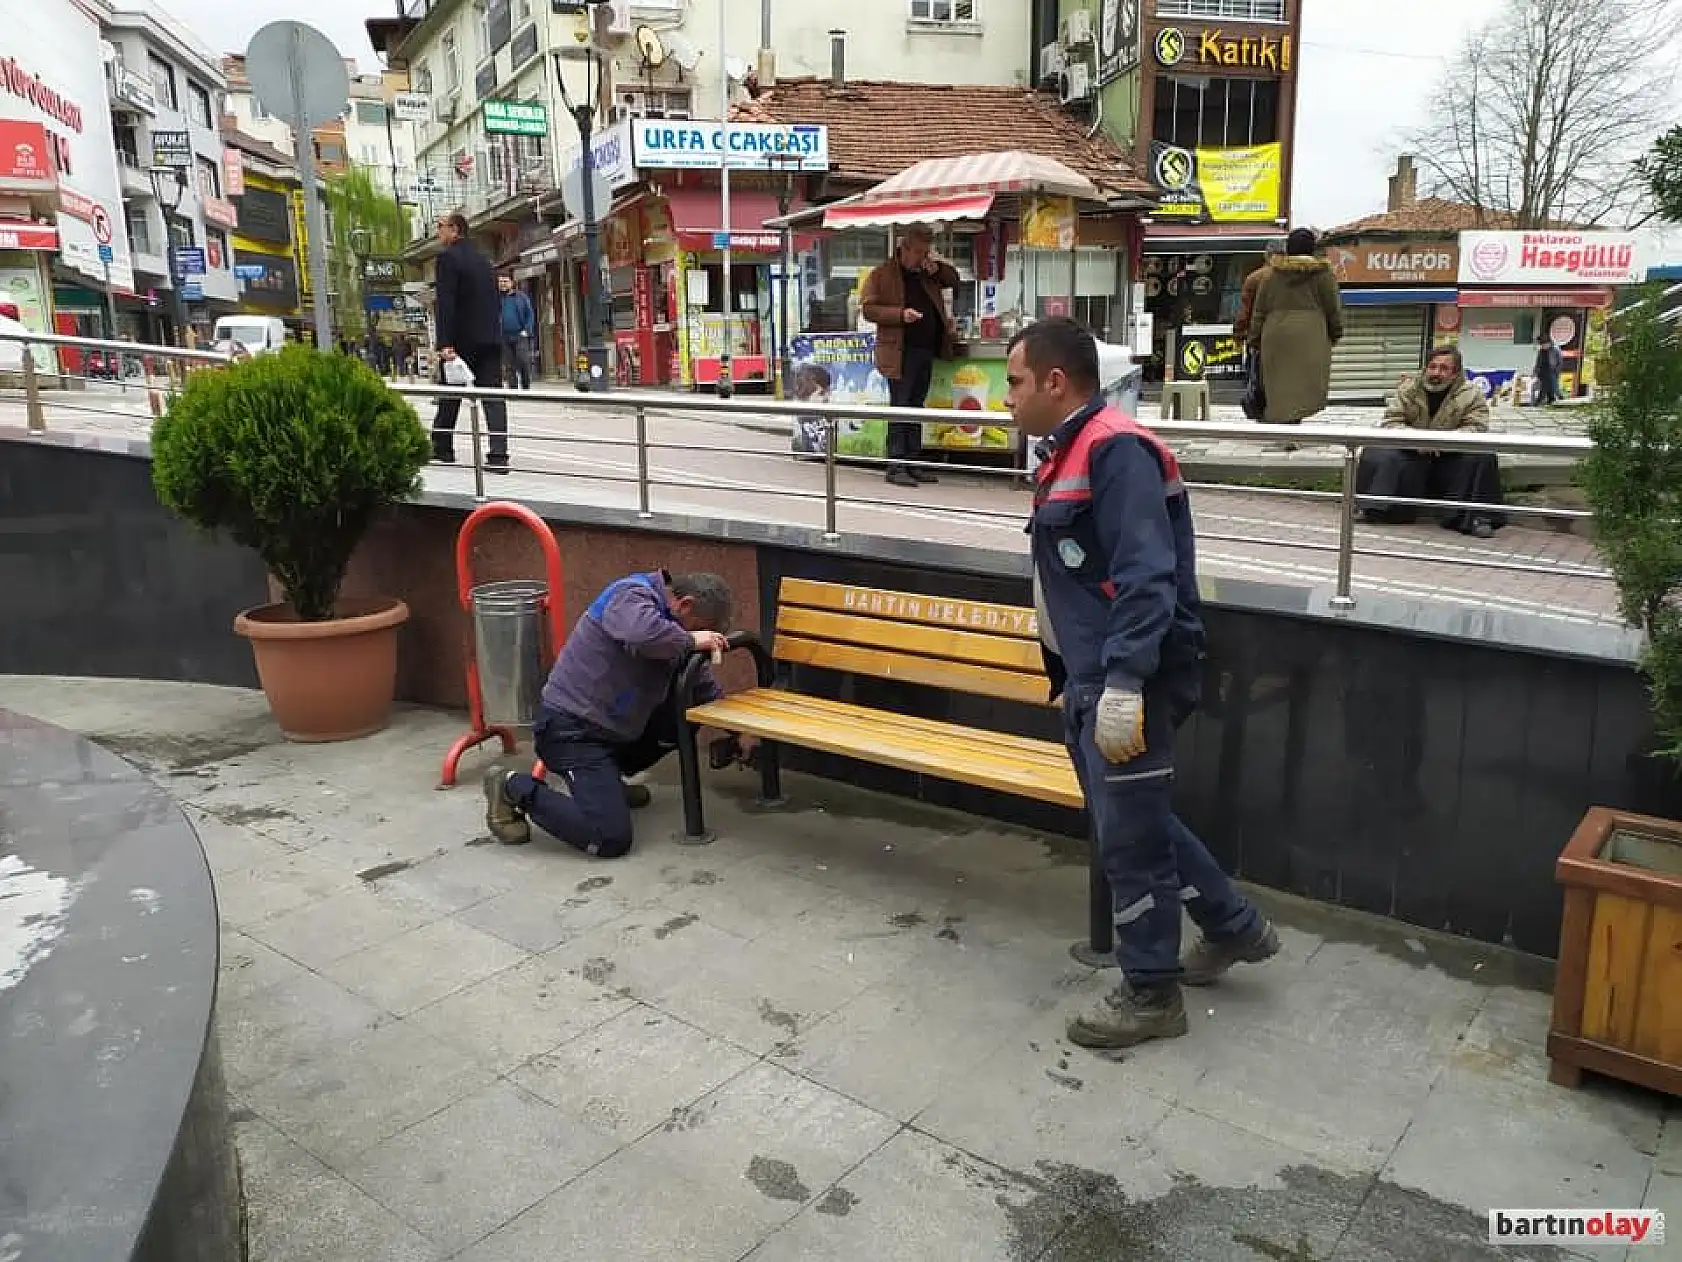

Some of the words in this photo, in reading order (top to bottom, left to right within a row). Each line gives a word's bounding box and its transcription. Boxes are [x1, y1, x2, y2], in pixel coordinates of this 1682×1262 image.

[645, 127, 705, 150] URFA
[711, 130, 819, 155] OCAKBAŞI
[1367, 248, 1452, 271] KUAFÖR
[1521, 244, 1631, 273] Hasgüllü
[844, 589, 920, 617] BARTIN
